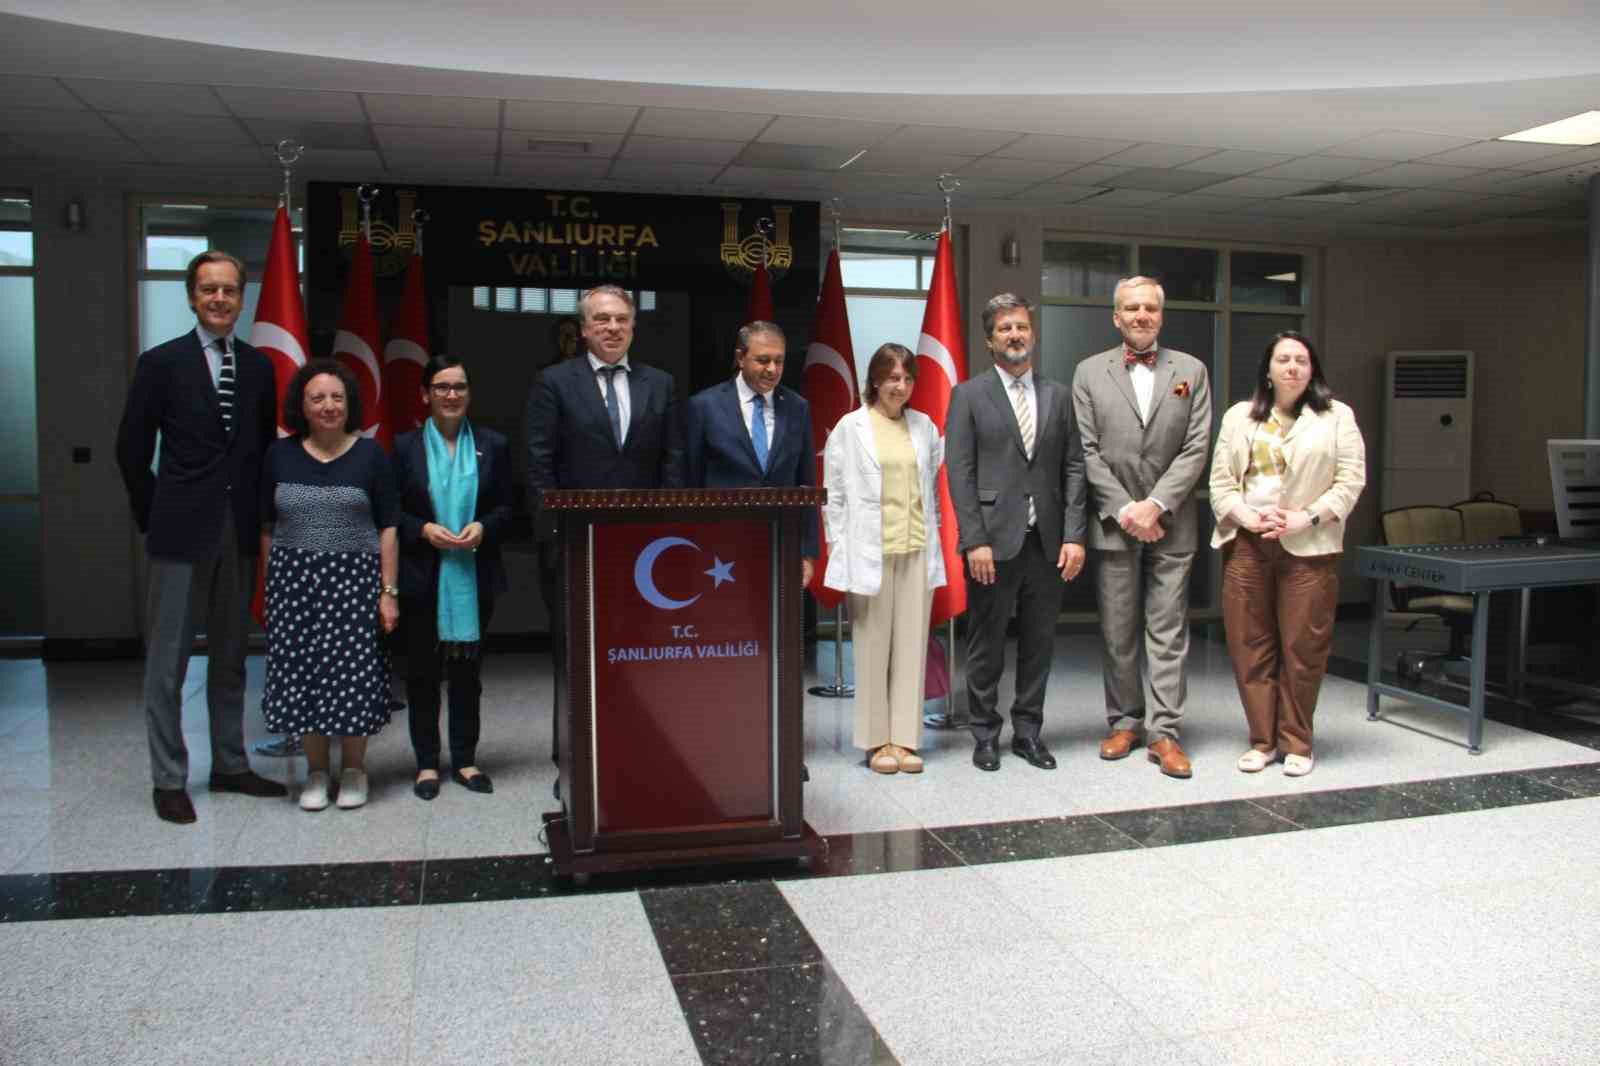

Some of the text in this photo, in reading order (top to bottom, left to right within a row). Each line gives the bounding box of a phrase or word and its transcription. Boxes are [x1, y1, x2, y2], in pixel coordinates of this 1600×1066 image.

[544, 194, 600, 219] T.C.
[479, 221, 659, 248] ŞANLIURFA
[508, 249, 640, 279] VALİLİĞİ
[671, 624, 700, 639] T.C.
[607, 640, 760, 664] ŞANLIURFA VALİLİĞİ
